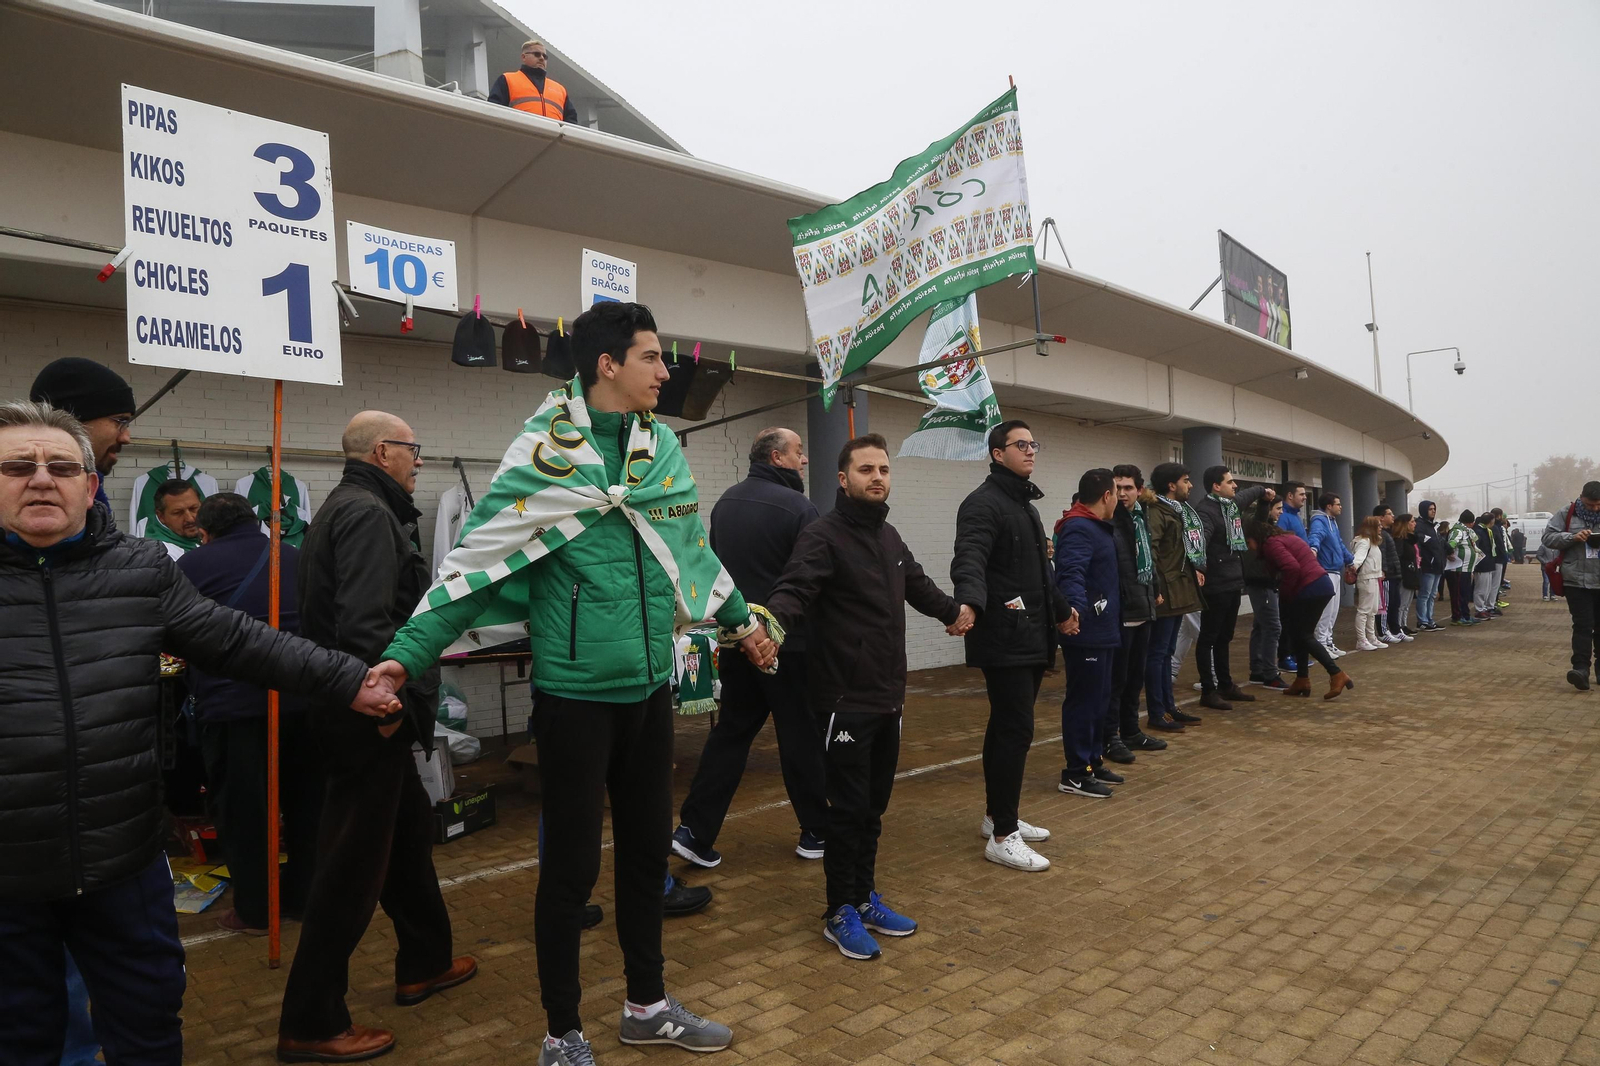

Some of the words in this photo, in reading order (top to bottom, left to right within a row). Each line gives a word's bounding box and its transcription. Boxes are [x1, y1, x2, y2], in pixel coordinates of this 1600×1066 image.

[128, 99, 178, 135] PIPAS
[130, 151, 185, 187] KIKOS
[253, 142, 322, 222] 3
[131, 204, 233, 248] REVUELTOS
[248, 218, 328, 242] PAQUETES
[364, 232, 443, 256] SUDADERAS
[134, 259, 209, 297] CHICLES
[591, 259, 630, 277] GORROS
[607, 272, 615, 281] O
[591, 277, 630, 294] BRAGAS
[262, 262, 313, 345] 1
[135, 315, 242, 355] CARAMELOS
[282, 345, 324, 360] EURO
[464, 791, 488, 807] unexport
